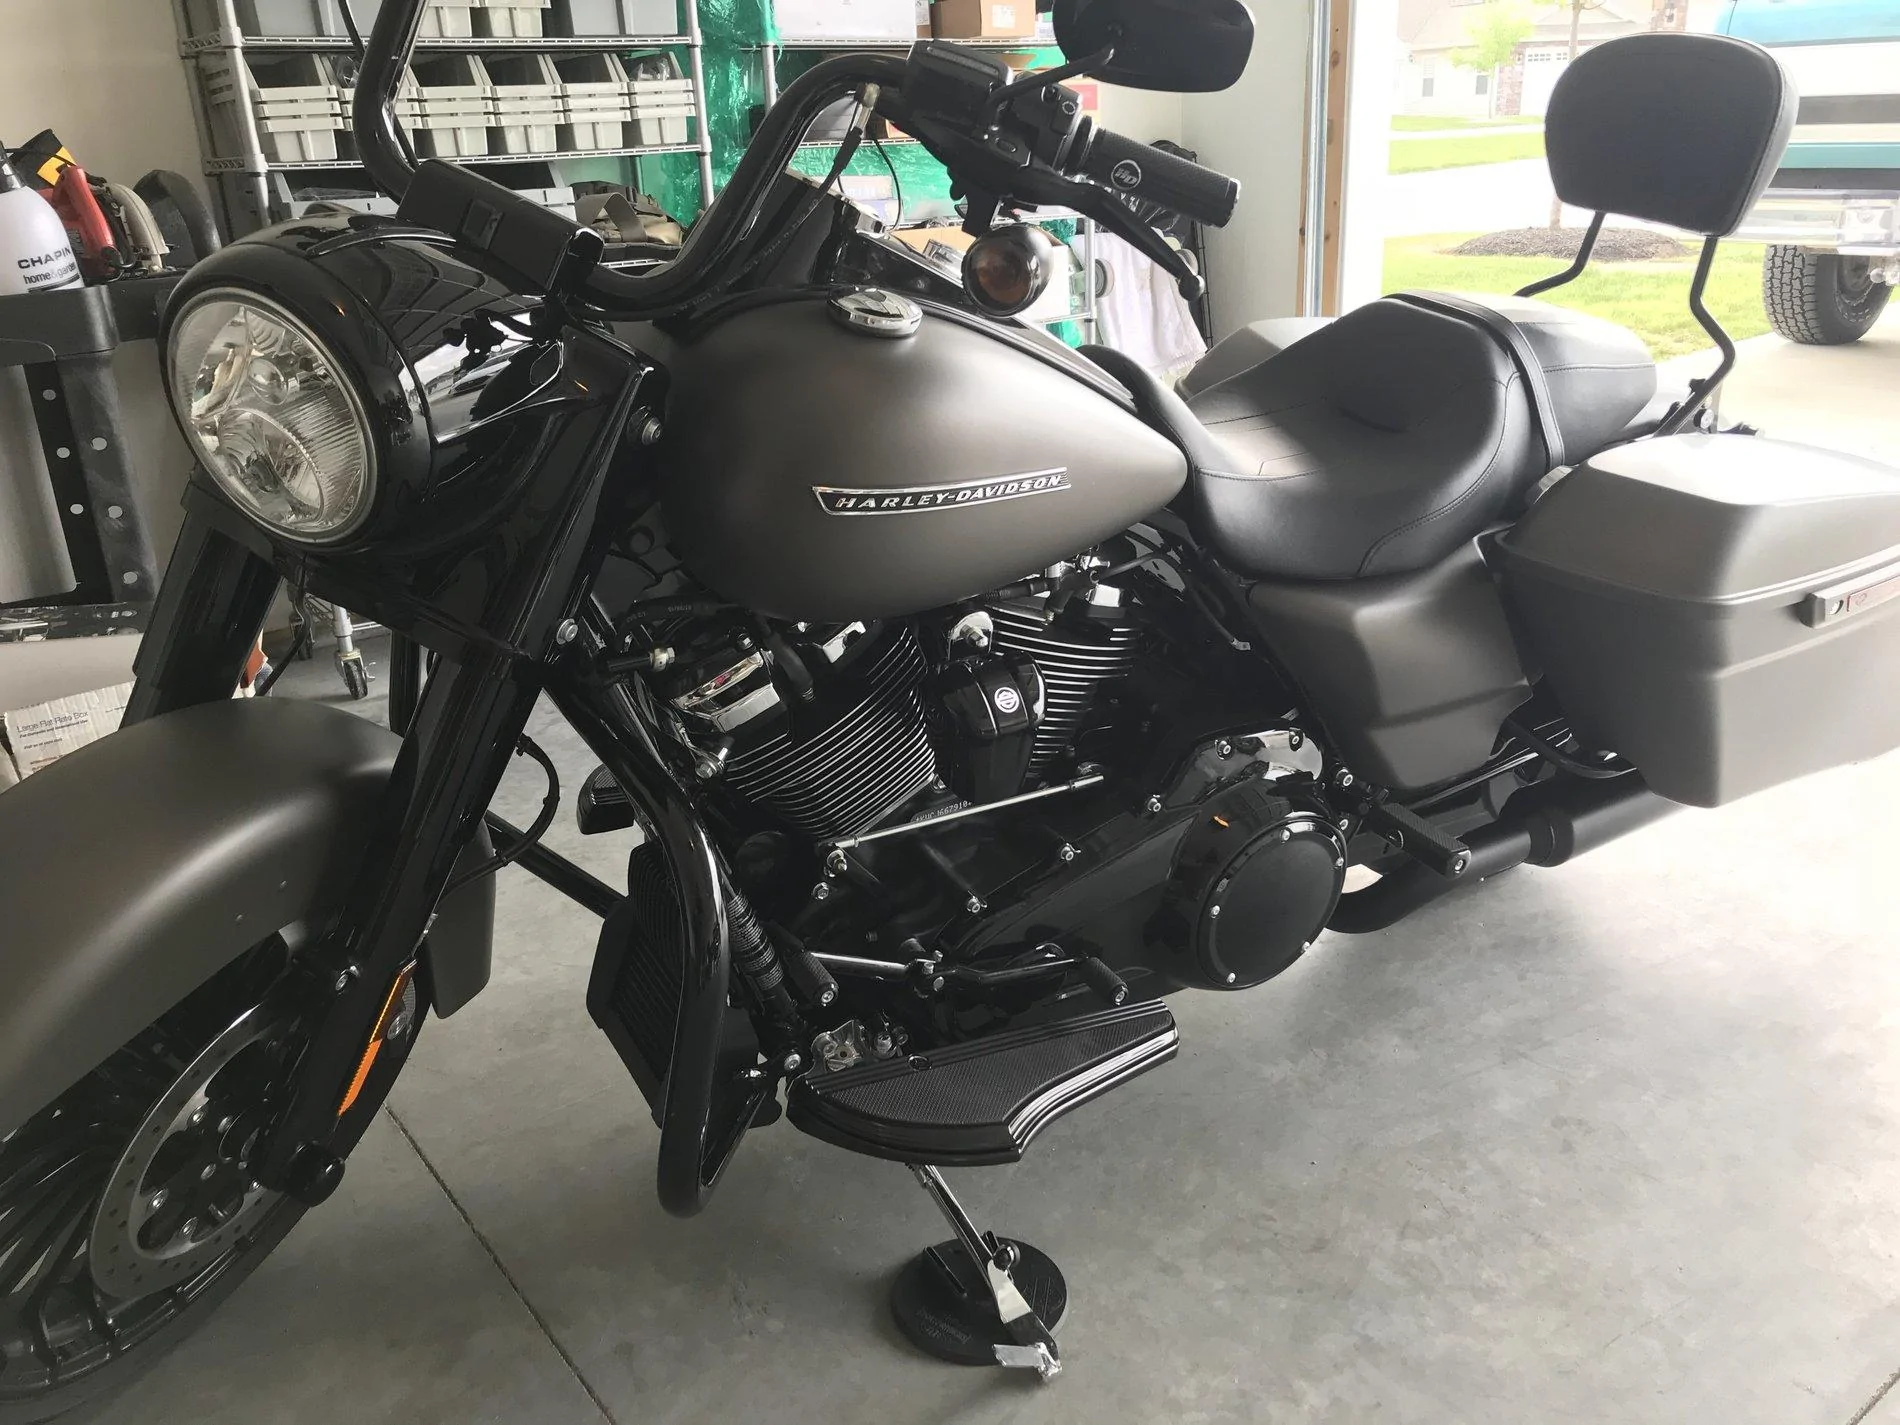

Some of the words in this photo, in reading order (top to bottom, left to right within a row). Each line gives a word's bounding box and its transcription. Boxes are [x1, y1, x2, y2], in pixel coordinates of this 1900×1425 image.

[18, 247, 72, 269] CHAPIN
[835, 475, 1063, 509] HARLEY-DAVIDSON
[16, 722, 39, 733] Large
[40, 719, 54, 728] Flat
[55, 715, 73, 725] Rate
[74, 711, 89, 720] Box
